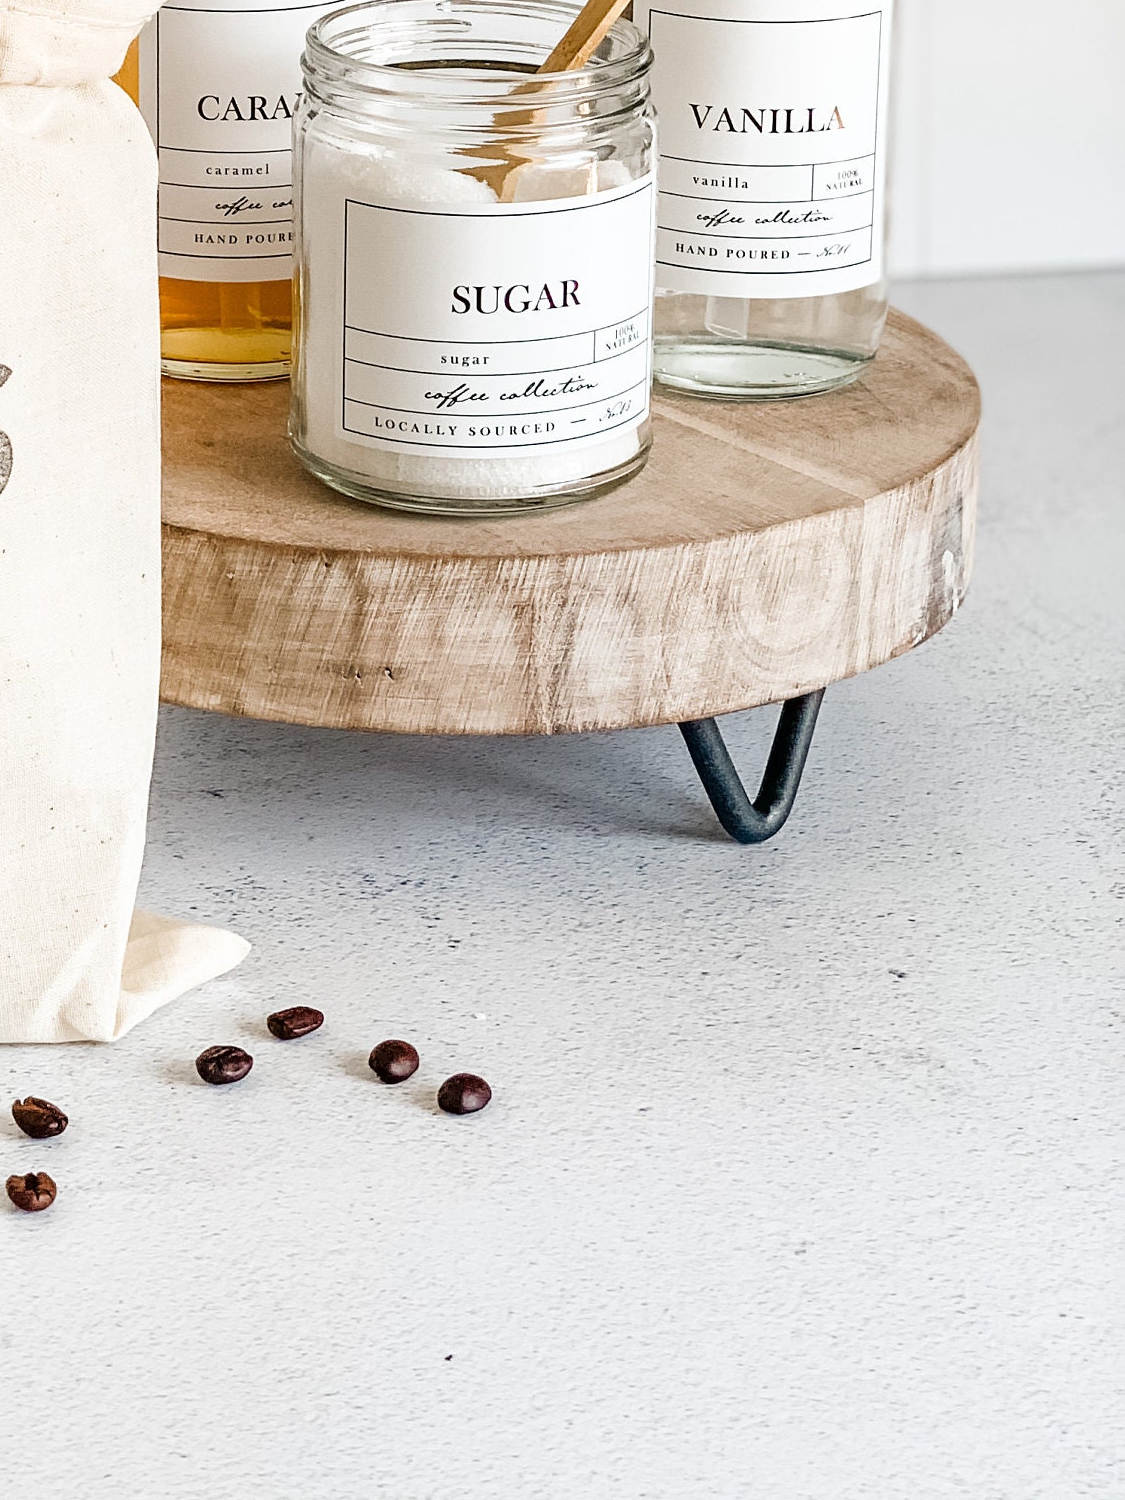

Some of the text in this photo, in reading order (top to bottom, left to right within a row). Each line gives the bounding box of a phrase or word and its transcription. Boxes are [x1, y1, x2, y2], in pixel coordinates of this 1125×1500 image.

[197, 92, 303, 122] CARA
[688, 103, 846, 134] VANILLA
[205, 163, 271, 176] caramel
[692, 174, 749, 190] vanilla
[825, 178, 864, 191] NATURAL
[215, 196, 263, 216] coffee
[696, 209, 833, 228] coffee collection
[194, 232, 238, 245] HAND
[675, 242, 718, 258] HAND
[726, 248, 790, 260] POURED
[451, 279, 581, 315] SUGAR
[440, 354, 490, 367] sugar
[424, 374, 598, 409] coffee collection
[374, 416, 458, 437] LOCALLY
[468, 421, 555, 437] SOURCED
